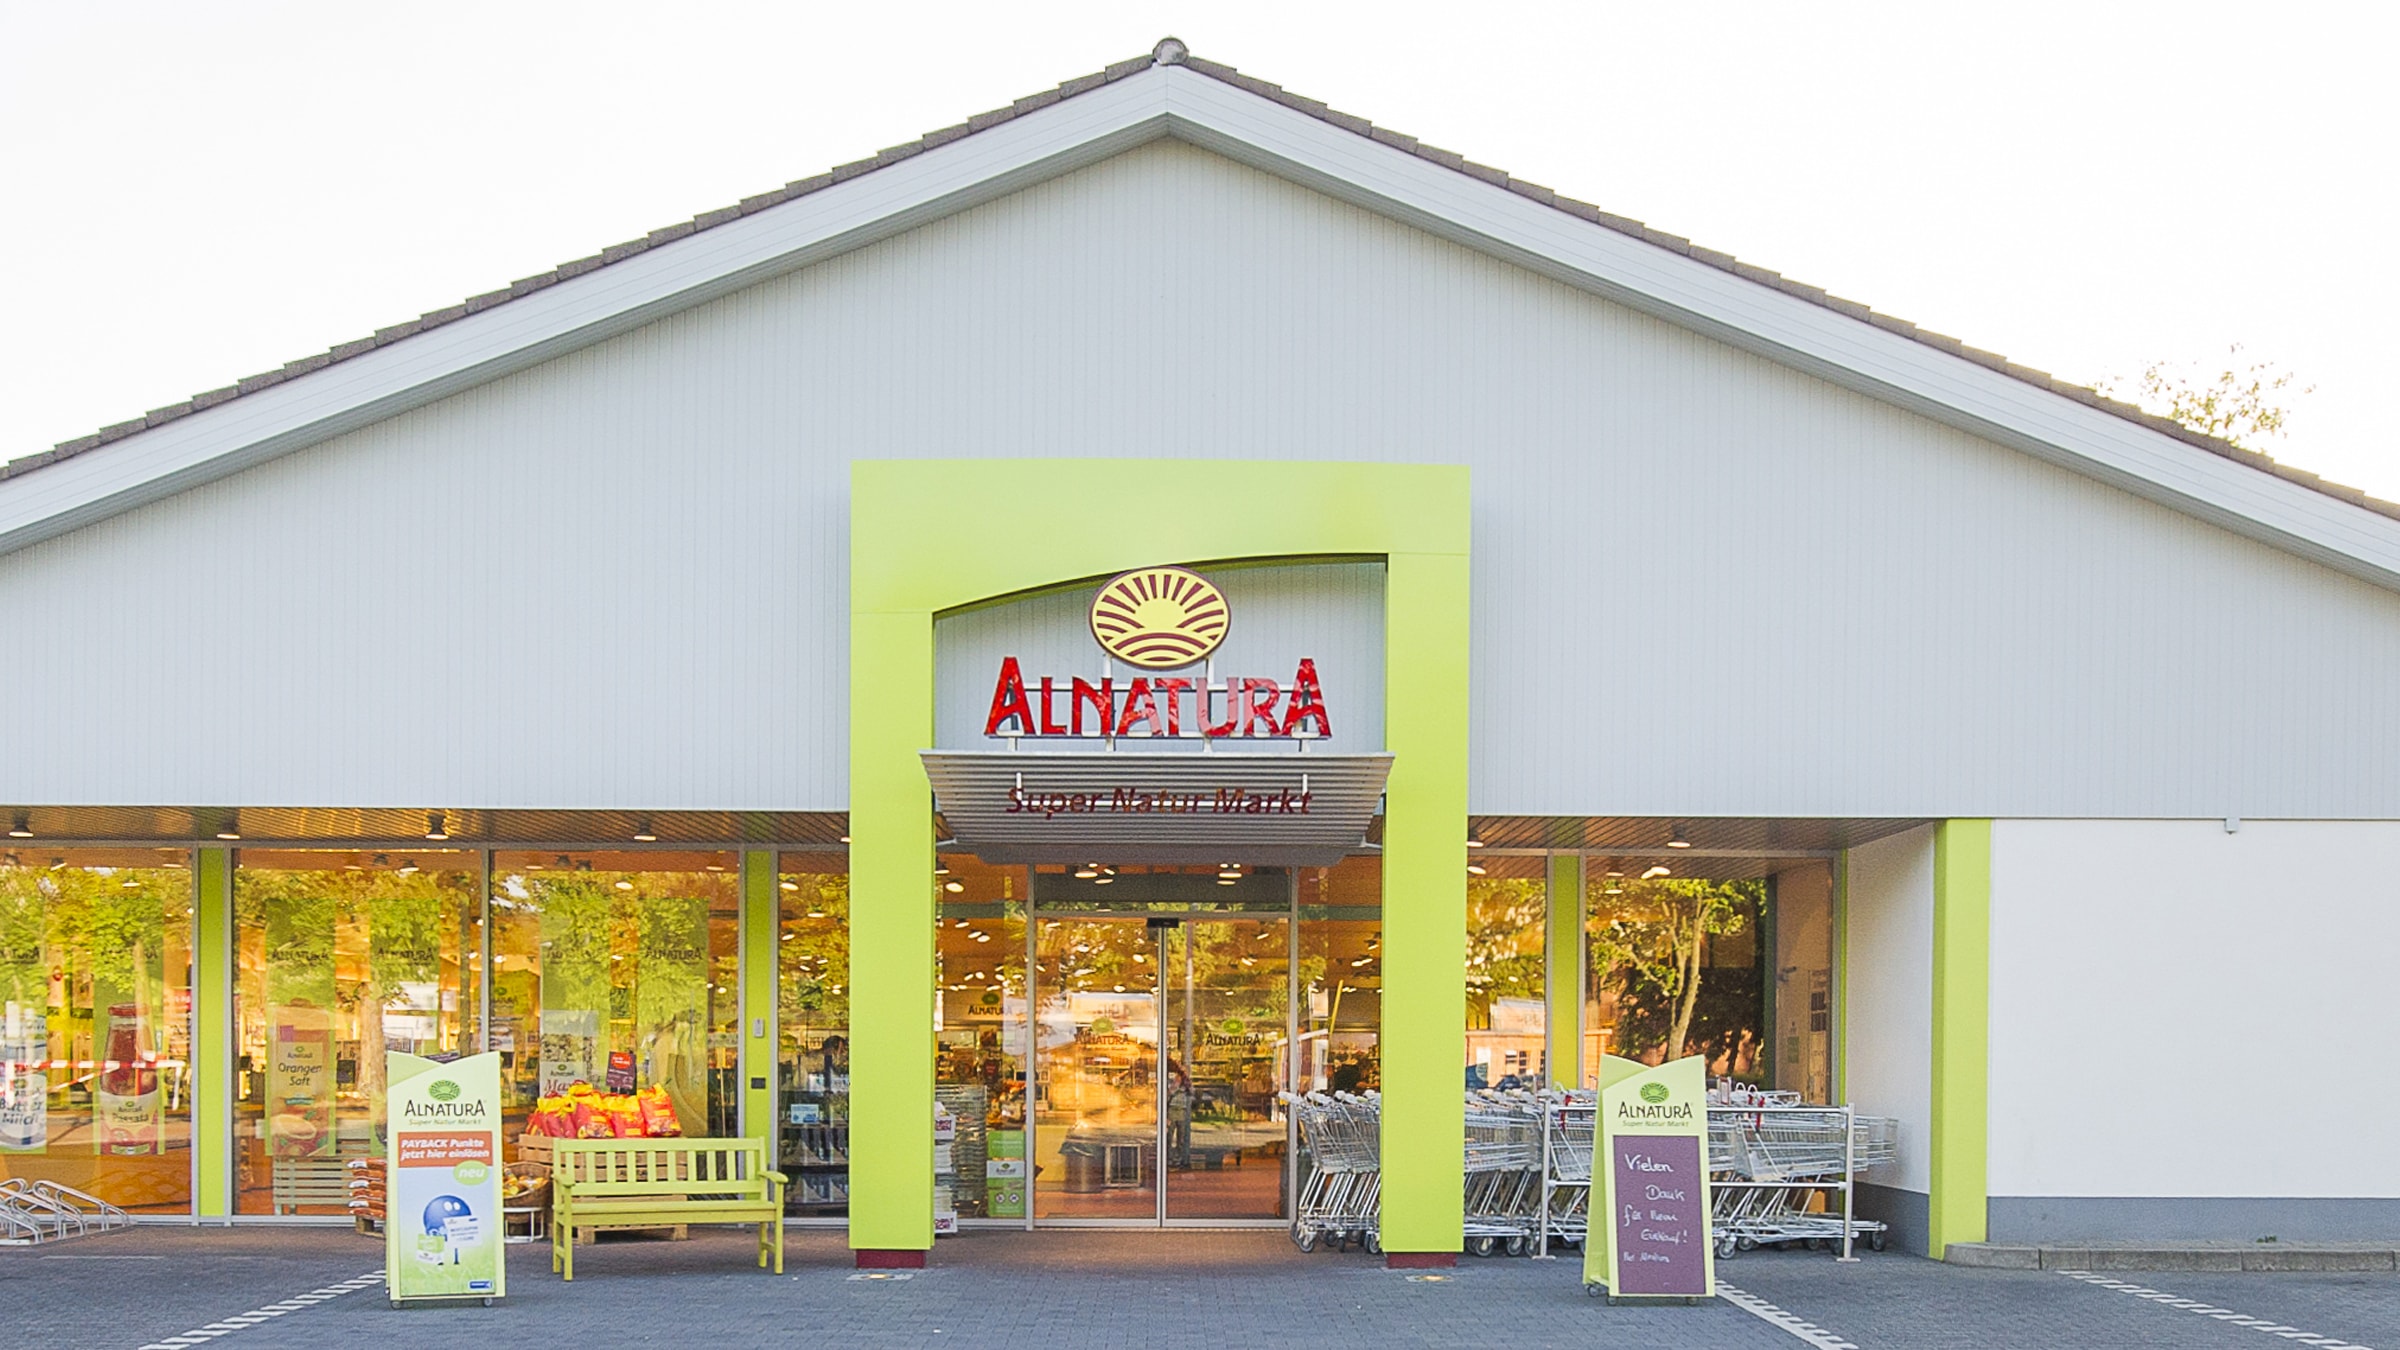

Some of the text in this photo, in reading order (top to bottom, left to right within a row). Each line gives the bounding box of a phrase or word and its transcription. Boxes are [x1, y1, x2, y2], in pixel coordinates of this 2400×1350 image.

[984, 656, 1332, 737] ALNATURA
[1006, 786, 1313, 821] Super Natur Markt
[289, 1075, 311, 1087] Saft
[405, 1099, 486, 1117] ALNATURA
[1618, 1101, 1693, 1119] ALNATURA
[401, 1138, 485, 1149] PAYBACK Punkte
[400, 1149, 490, 1162] jetzt hier einlösen
[1624, 1153, 1675, 1172] Vielen
[458, 1168, 485, 1178] neu
[1645, 1184, 1686, 1202] Dank
[1623, 1204, 1643, 1228] für
